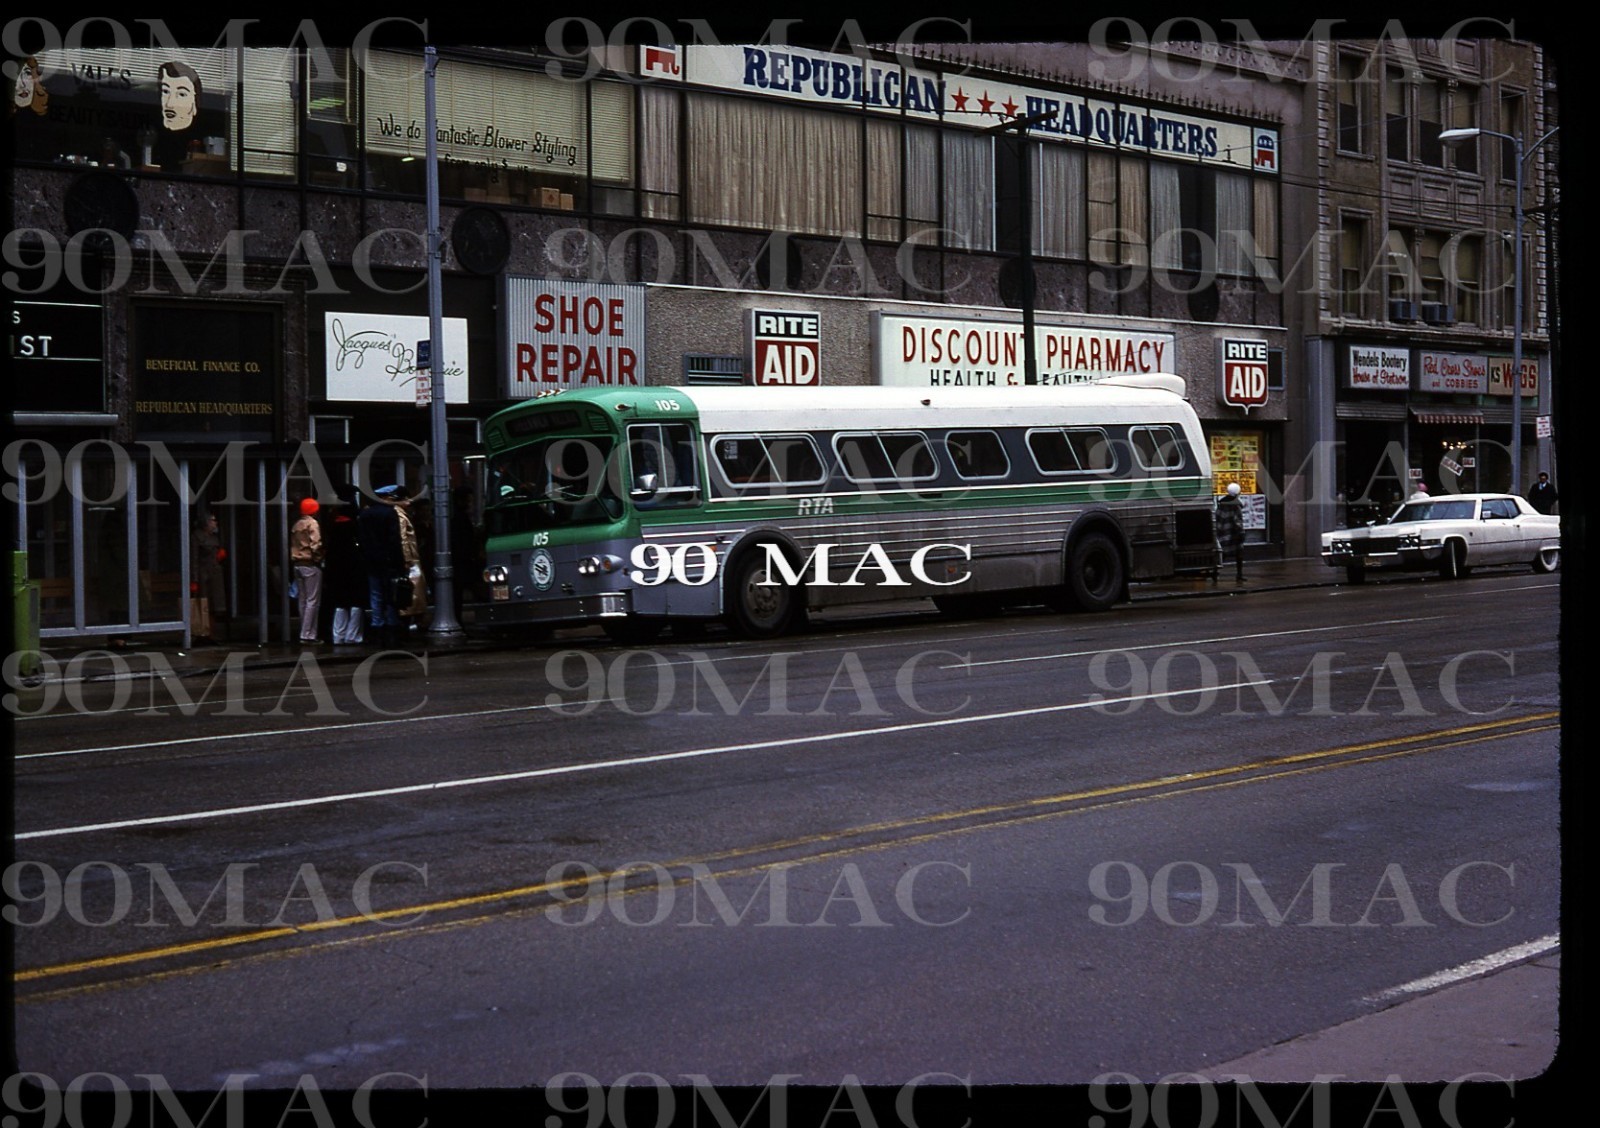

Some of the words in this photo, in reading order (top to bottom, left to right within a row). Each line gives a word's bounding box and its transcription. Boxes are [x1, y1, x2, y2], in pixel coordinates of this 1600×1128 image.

[743, 47, 946, 115] REPUBLICAN
[1025, 95, 1218, 157] HEADQUARTERS
[377, 113, 402, 137] We
[407, 120, 421, 139] do
[483, 126, 528, 152] Blower
[532, 131, 577, 166] Styling
[534, 294, 625, 337] SHOE
[759, 315, 818, 336] RITE
[903, 326, 1025, 367] DISCOUN
[1046, 335, 1165, 373] PHARMACY
[1228, 342, 1267, 359] RITE
[145, 359, 199, 372] BENEFICIAL
[202, 360, 240, 373] FINANCE
[244, 362, 261, 374] CO.
[517, 343, 638, 385] REPAIR
[762, 344, 816, 385] AID
[1423, 356, 1438, 375] Red
[1441, 358, 1460, 377] Cross
[1463, 358, 1485, 377] Shoes
[1230, 366, 1266, 399] AID
[1445, 379, 1479, 389] COBBIES
[1502, 363, 1536, 389] WGS
[135, 401, 197, 414] REPUBLICAN
[199, 403, 273, 416] HEADQUARTERS
[654, 399, 681, 411] 105
[797, 497, 834, 516] RTA
[532, 531, 549, 547] 105
